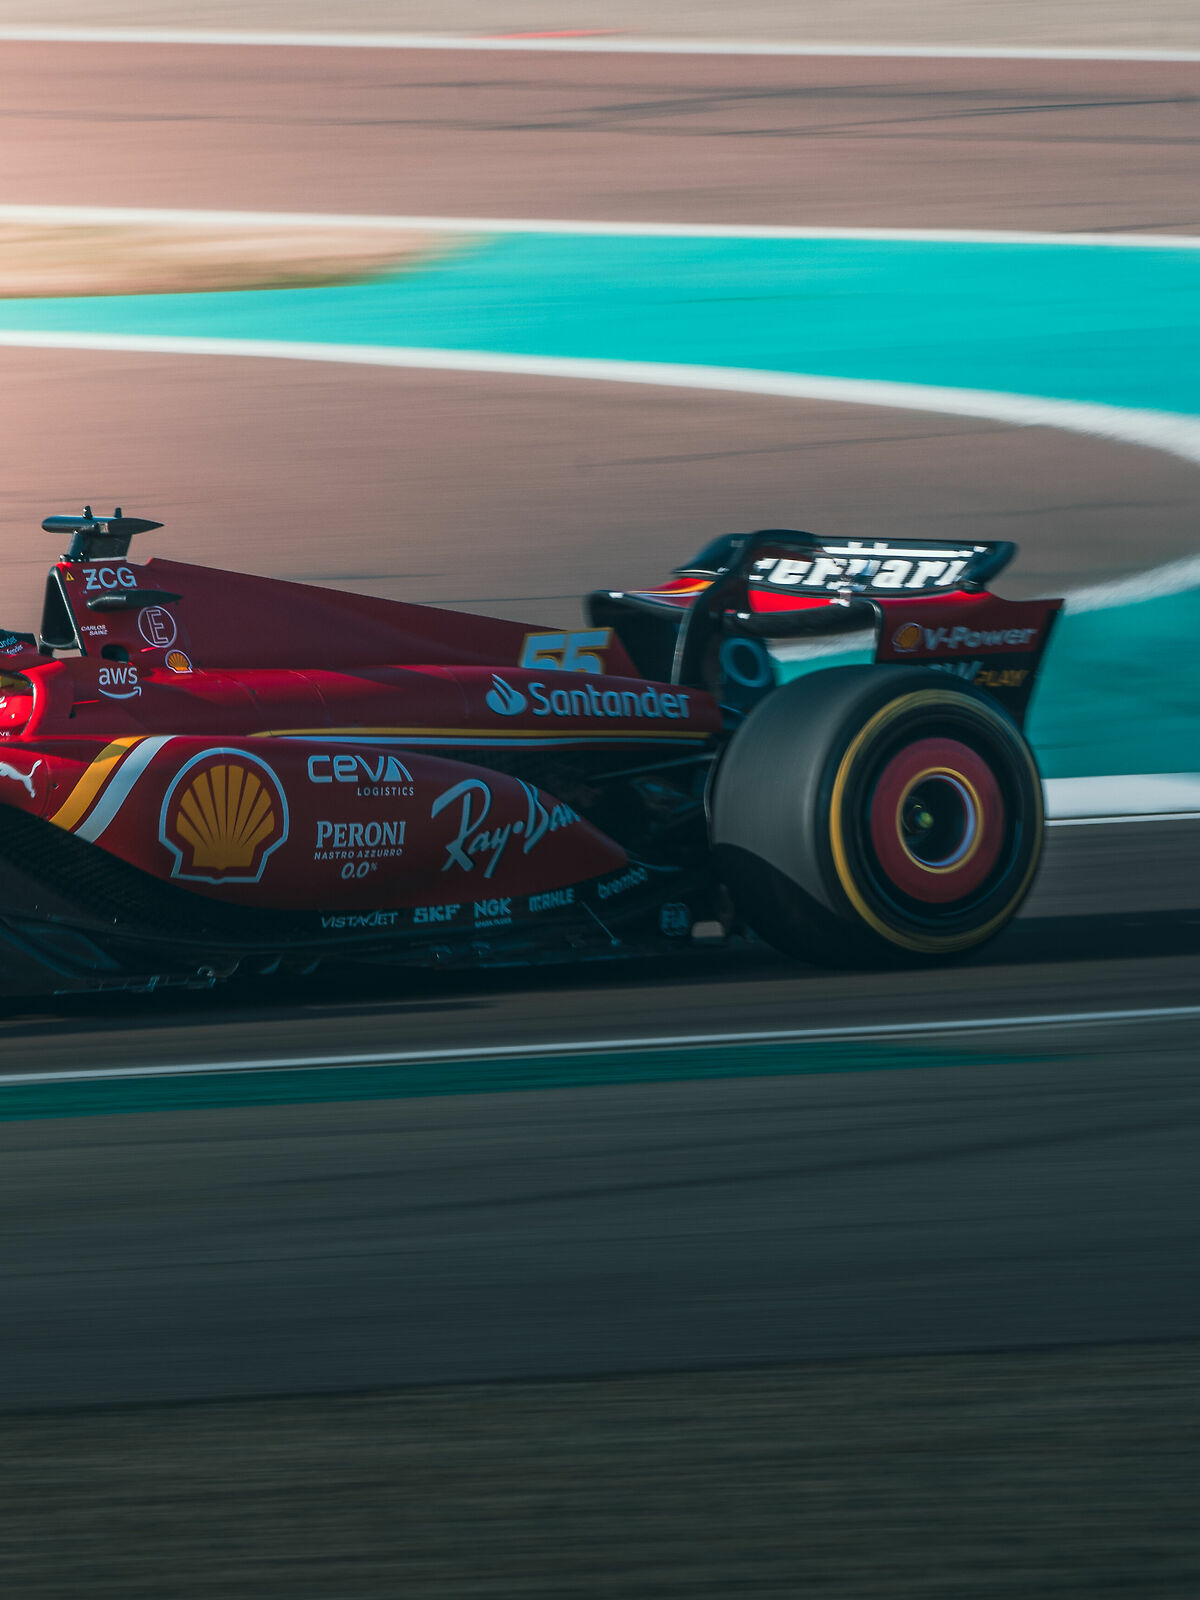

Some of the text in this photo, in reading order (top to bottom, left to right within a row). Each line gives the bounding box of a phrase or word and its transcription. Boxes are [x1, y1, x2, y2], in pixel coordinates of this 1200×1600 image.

[81, 624, 106, 632] CARLOS
[89, 629, 108, 637] SAINZ
[924, 626, 1037, 650] V-Power
[519, 627, 614, 674] 55
[98, 666, 138, 686] aws
[527, 682, 691, 719] Santander
[357, 787, 414, 797] LOGISTICS
[315, 820, 407, 848] PERONI
[314, 848, 402, 860] NASTRO AZZURRO
[413, 904, 461, 924] SKF
[473, 897, 512, 919] NGK
